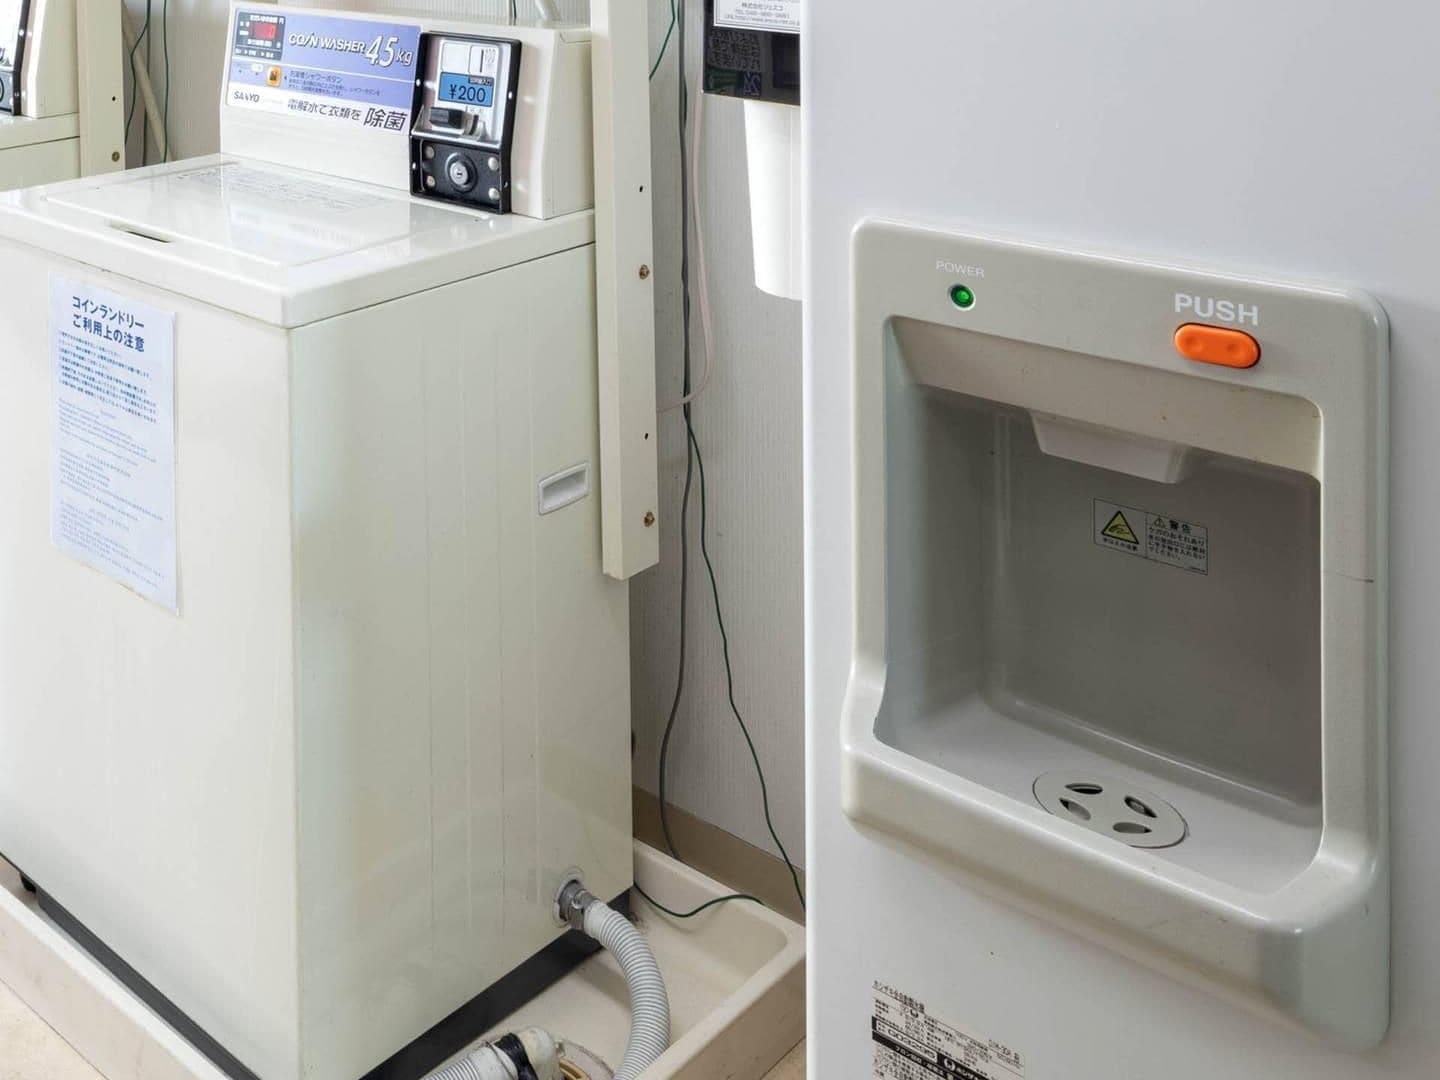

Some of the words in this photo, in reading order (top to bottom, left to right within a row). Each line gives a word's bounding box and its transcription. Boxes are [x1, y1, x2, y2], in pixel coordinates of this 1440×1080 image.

[320, 38, 367, 55] WASHER
[448, 83, 486, 103] ¥200
[363, 107, 408, 132] 除菌
[936, 260, 985, 278] POWER
[72, 295, 144, 328] コインランドリー
[1175, 293, 1259, 326] PUSH
[73, 314, 145, 352] ご利用上の注意
